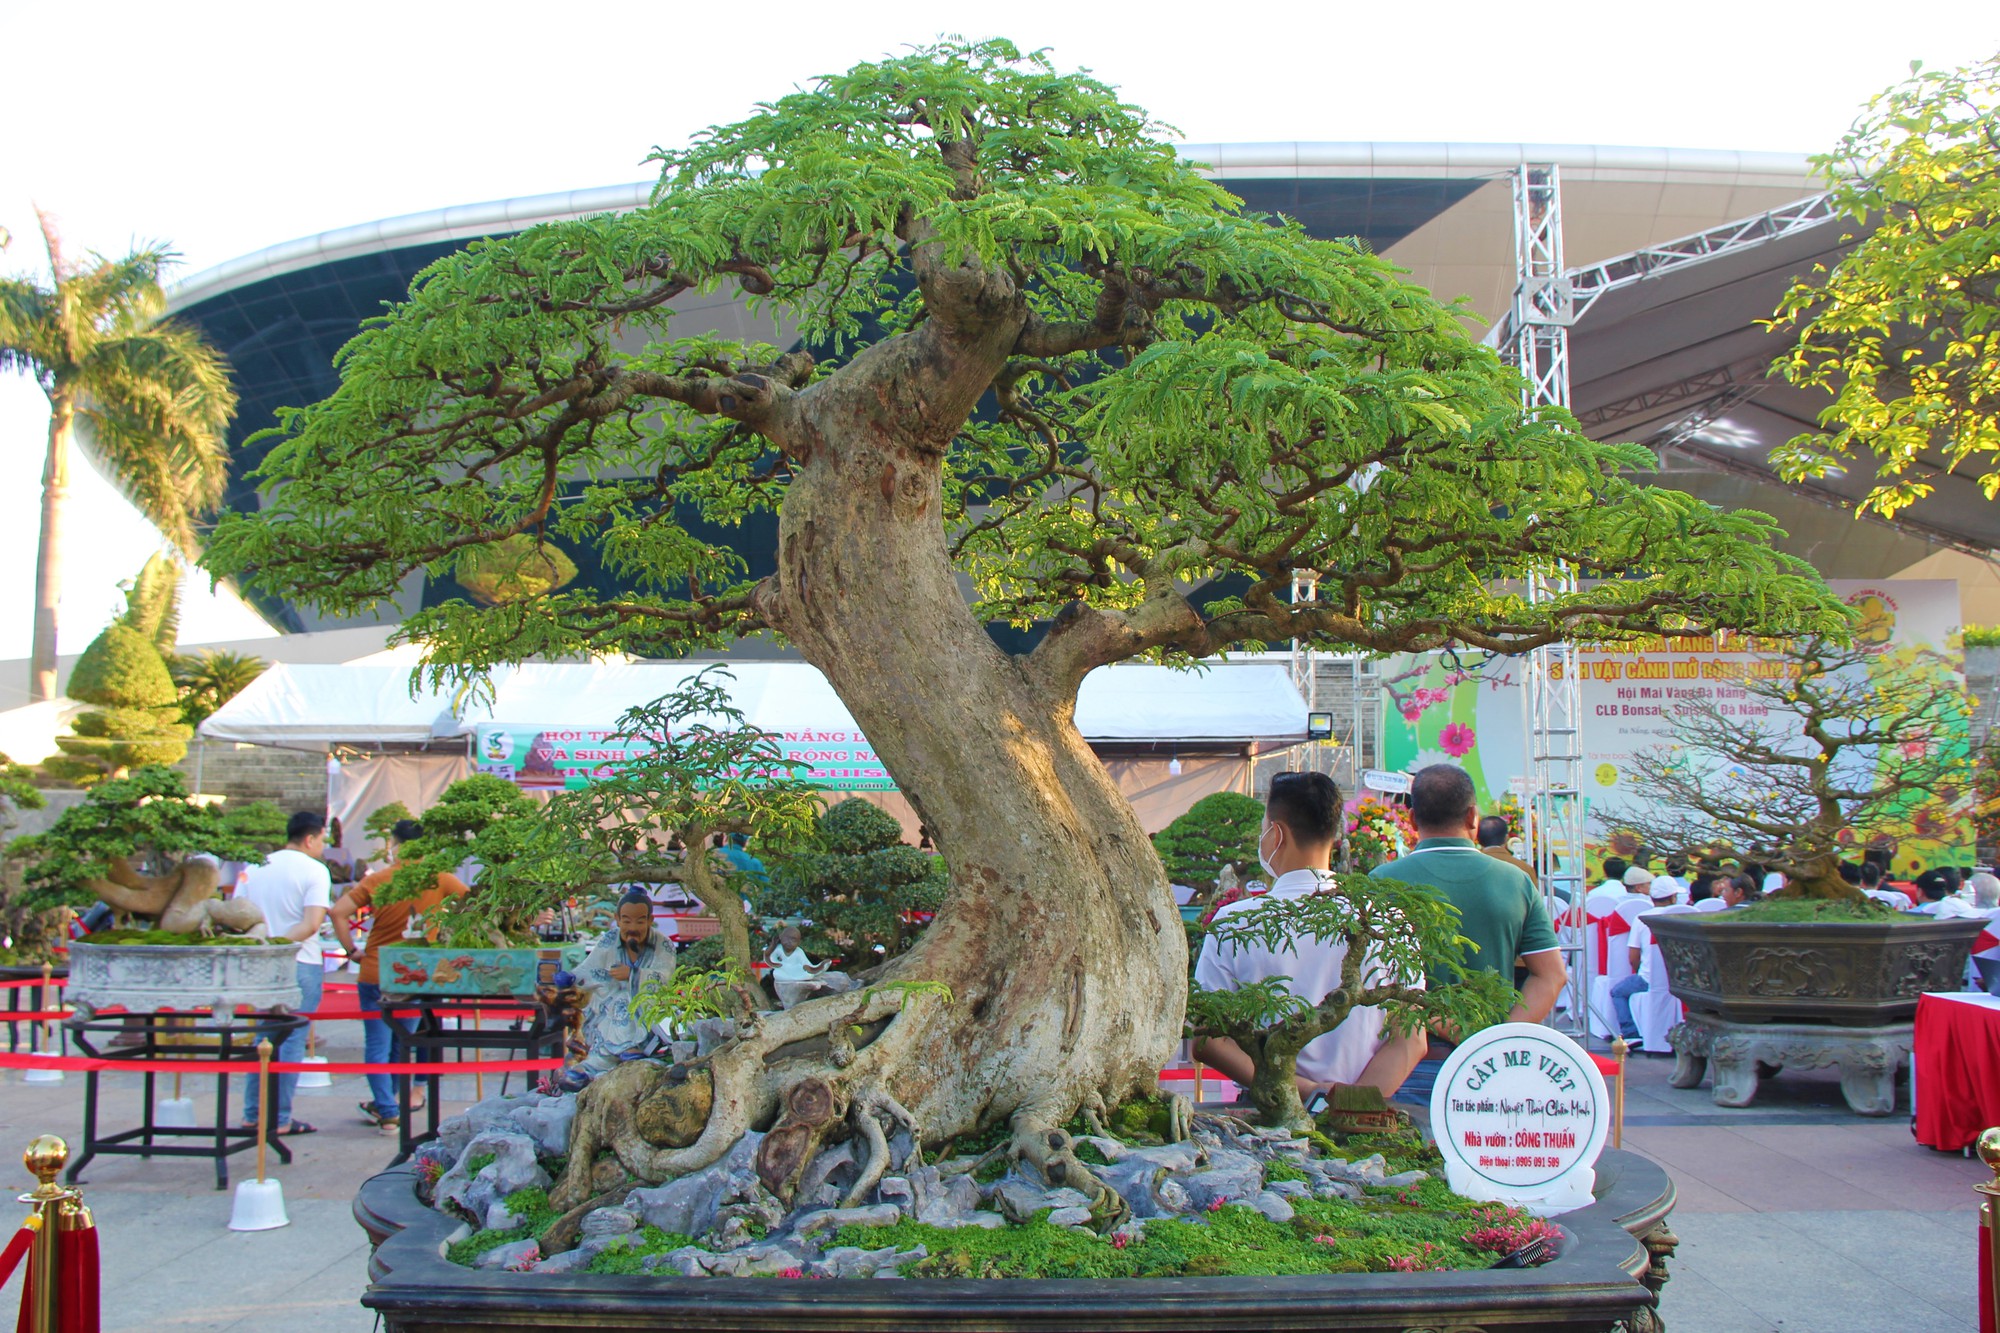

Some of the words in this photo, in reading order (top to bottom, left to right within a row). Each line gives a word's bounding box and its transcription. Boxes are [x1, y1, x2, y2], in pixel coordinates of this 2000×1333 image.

[1592, 658, 1622, 682] VẬT
[1625, 656, 1671, 680] CẢNH
[1672, 656, 1698, 680] MỞ
[1617, 686, 1636, 701] Hội
[1640, 686, 1662, 698] Mai
[1596, 704, 1618, 716] CLB
[1622, 704, 1662, 716] Bonsai
[1720, 703, 1735, 716] Đà
[543, 728, 582, 744] HỘI
[538, 746, 569, 761] VÀ
[574, 749, 626, 761] SINH
[788, 748, 849, 764] RỘNG
[1467, 1057, 1498, 1091] CÂY
[1503, 1050, 1531, 1068] ME
[1538, 1055, 1575, 1092] VIỆT
[1452, 1099, 1464, 1112] Tên
[1465, 1099, 1475, 1112] tác
[1571, 1099, 1590, 1118] Minh
[1464, 1130, 1482, 1147] Nhà
[1485, 1131, 1506, 1147] vườn
[1515, 1128, 1541, 1148] CÔNG
[1543, 1127, 1575, 1149] THUẤN
[1479, 1155, 1493, 1169] Điện
[1495, 1155, 1511, 1169] thoại
[1516, 1156, 1532, 1167] 0905
[1533, 1156, 1546, 1168] 091
